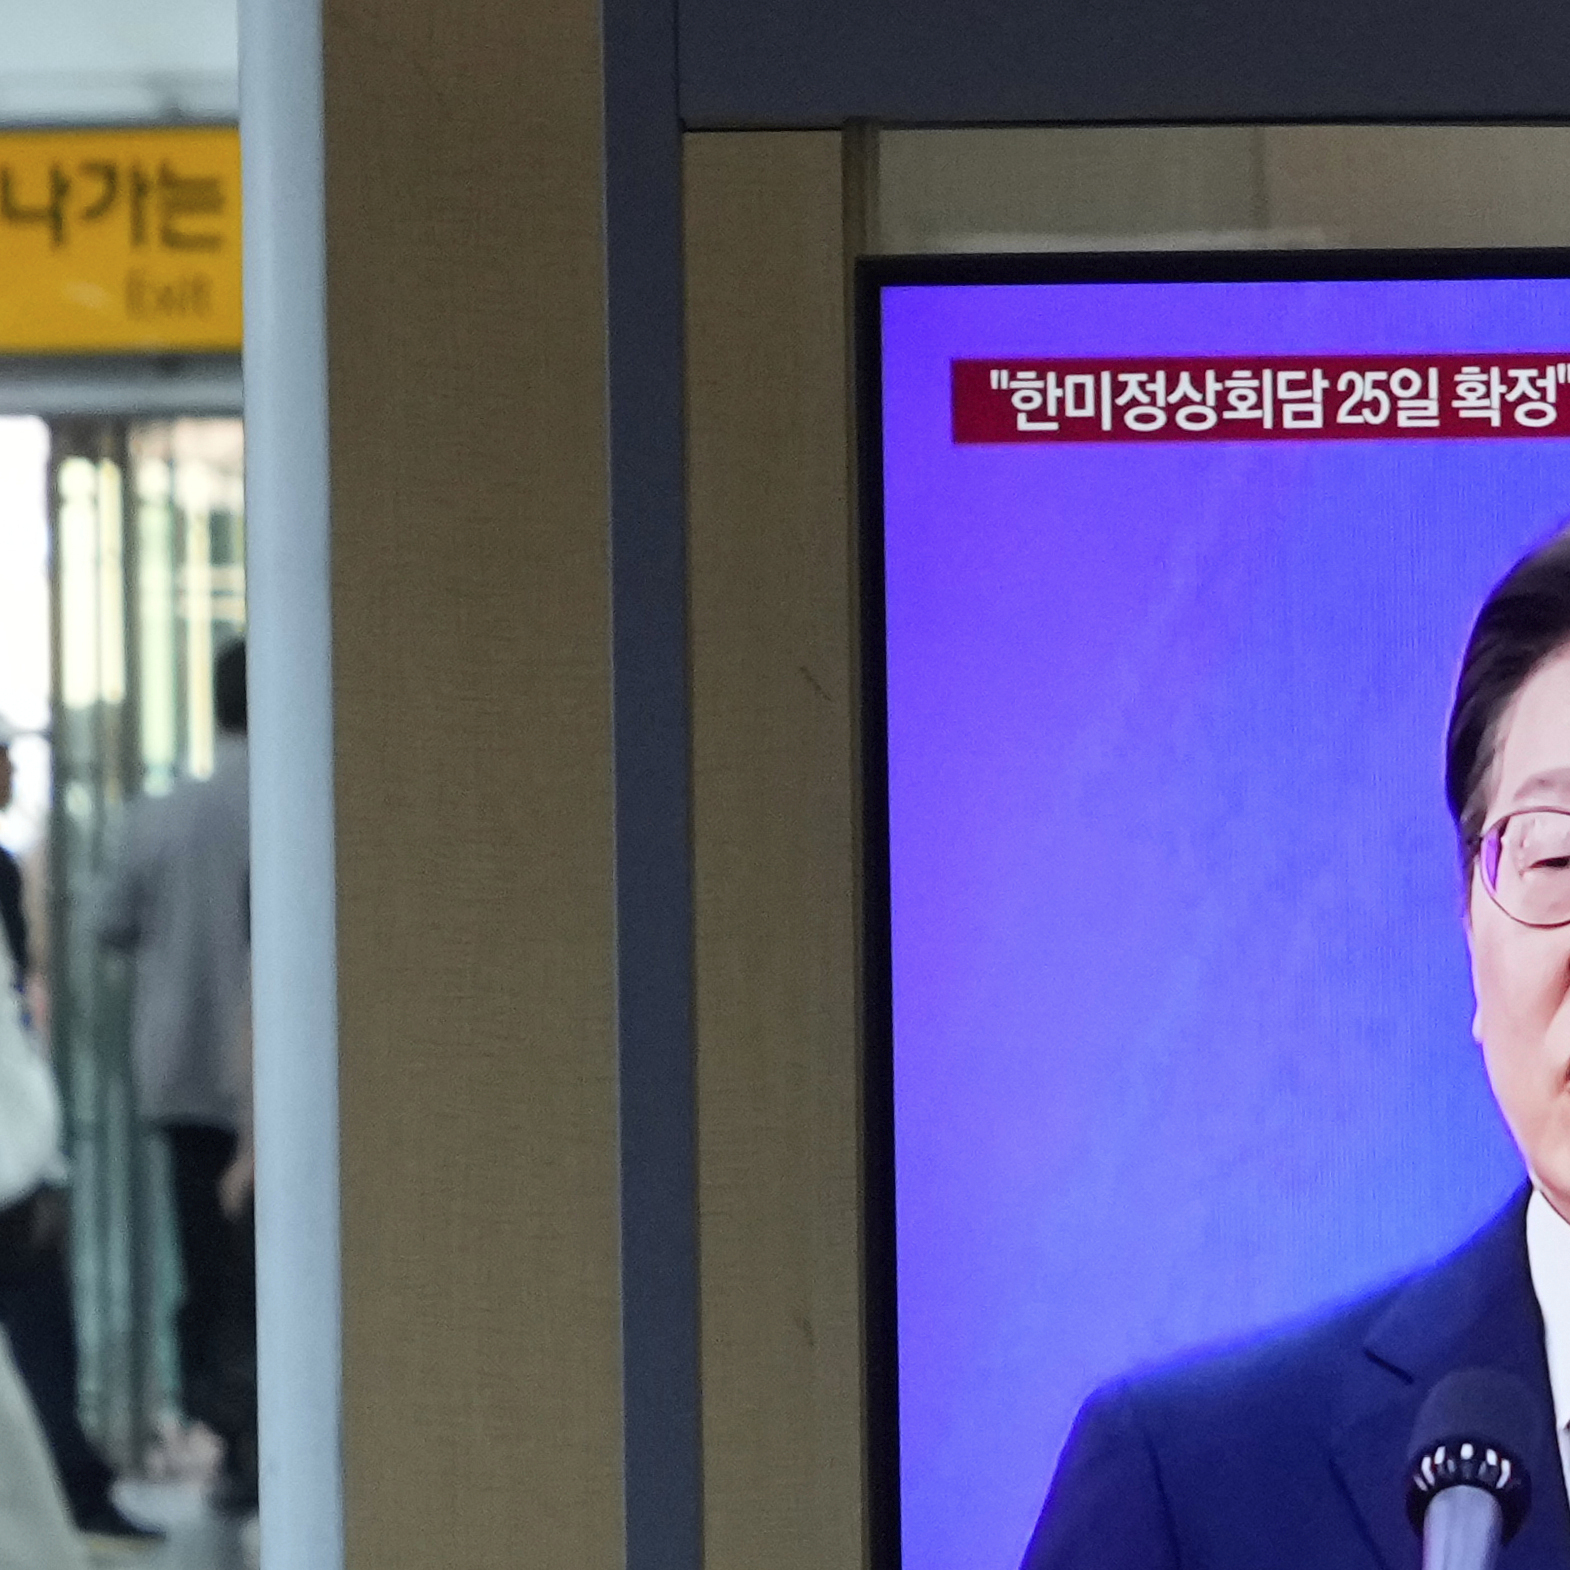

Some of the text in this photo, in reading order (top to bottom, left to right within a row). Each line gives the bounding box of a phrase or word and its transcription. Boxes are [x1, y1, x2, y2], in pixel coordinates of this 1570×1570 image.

[0, 160, 226, 252] 나가는
[990, 368, 1330, 431] "한미정상회담
[1336, 367, 1440, 428] 25일
